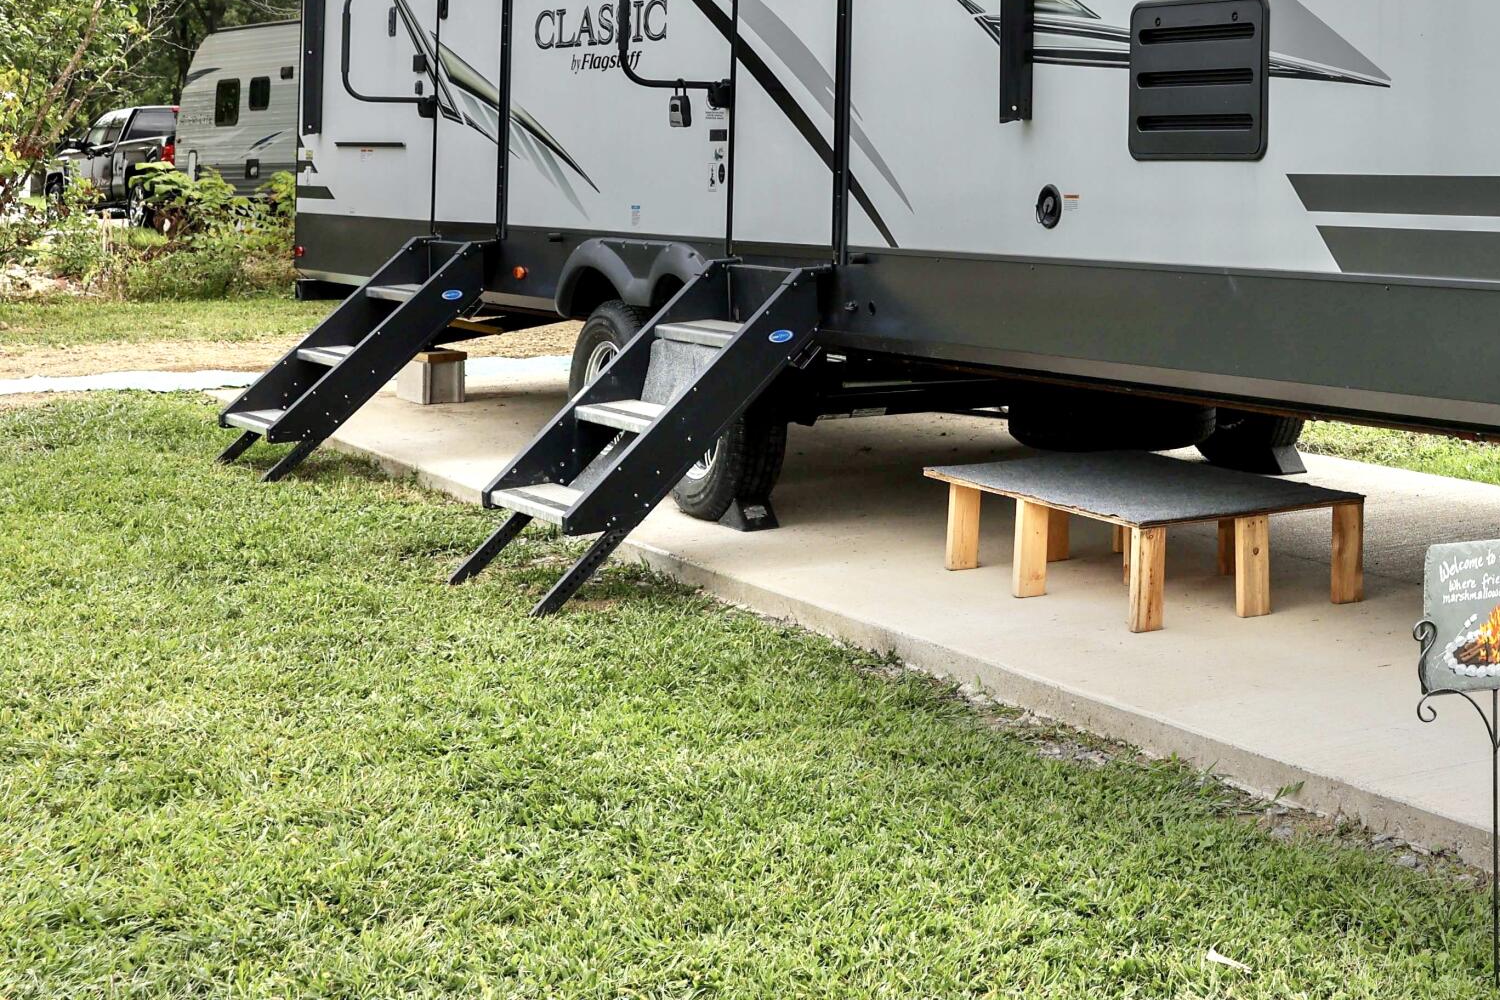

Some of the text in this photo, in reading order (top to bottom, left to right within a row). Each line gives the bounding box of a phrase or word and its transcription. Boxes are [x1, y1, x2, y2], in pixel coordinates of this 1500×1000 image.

[571, 51, 642, 74] by Flagstff
[1440, 556, 1484, 583] Welcome
[1486, 549, 1496, 566] to
